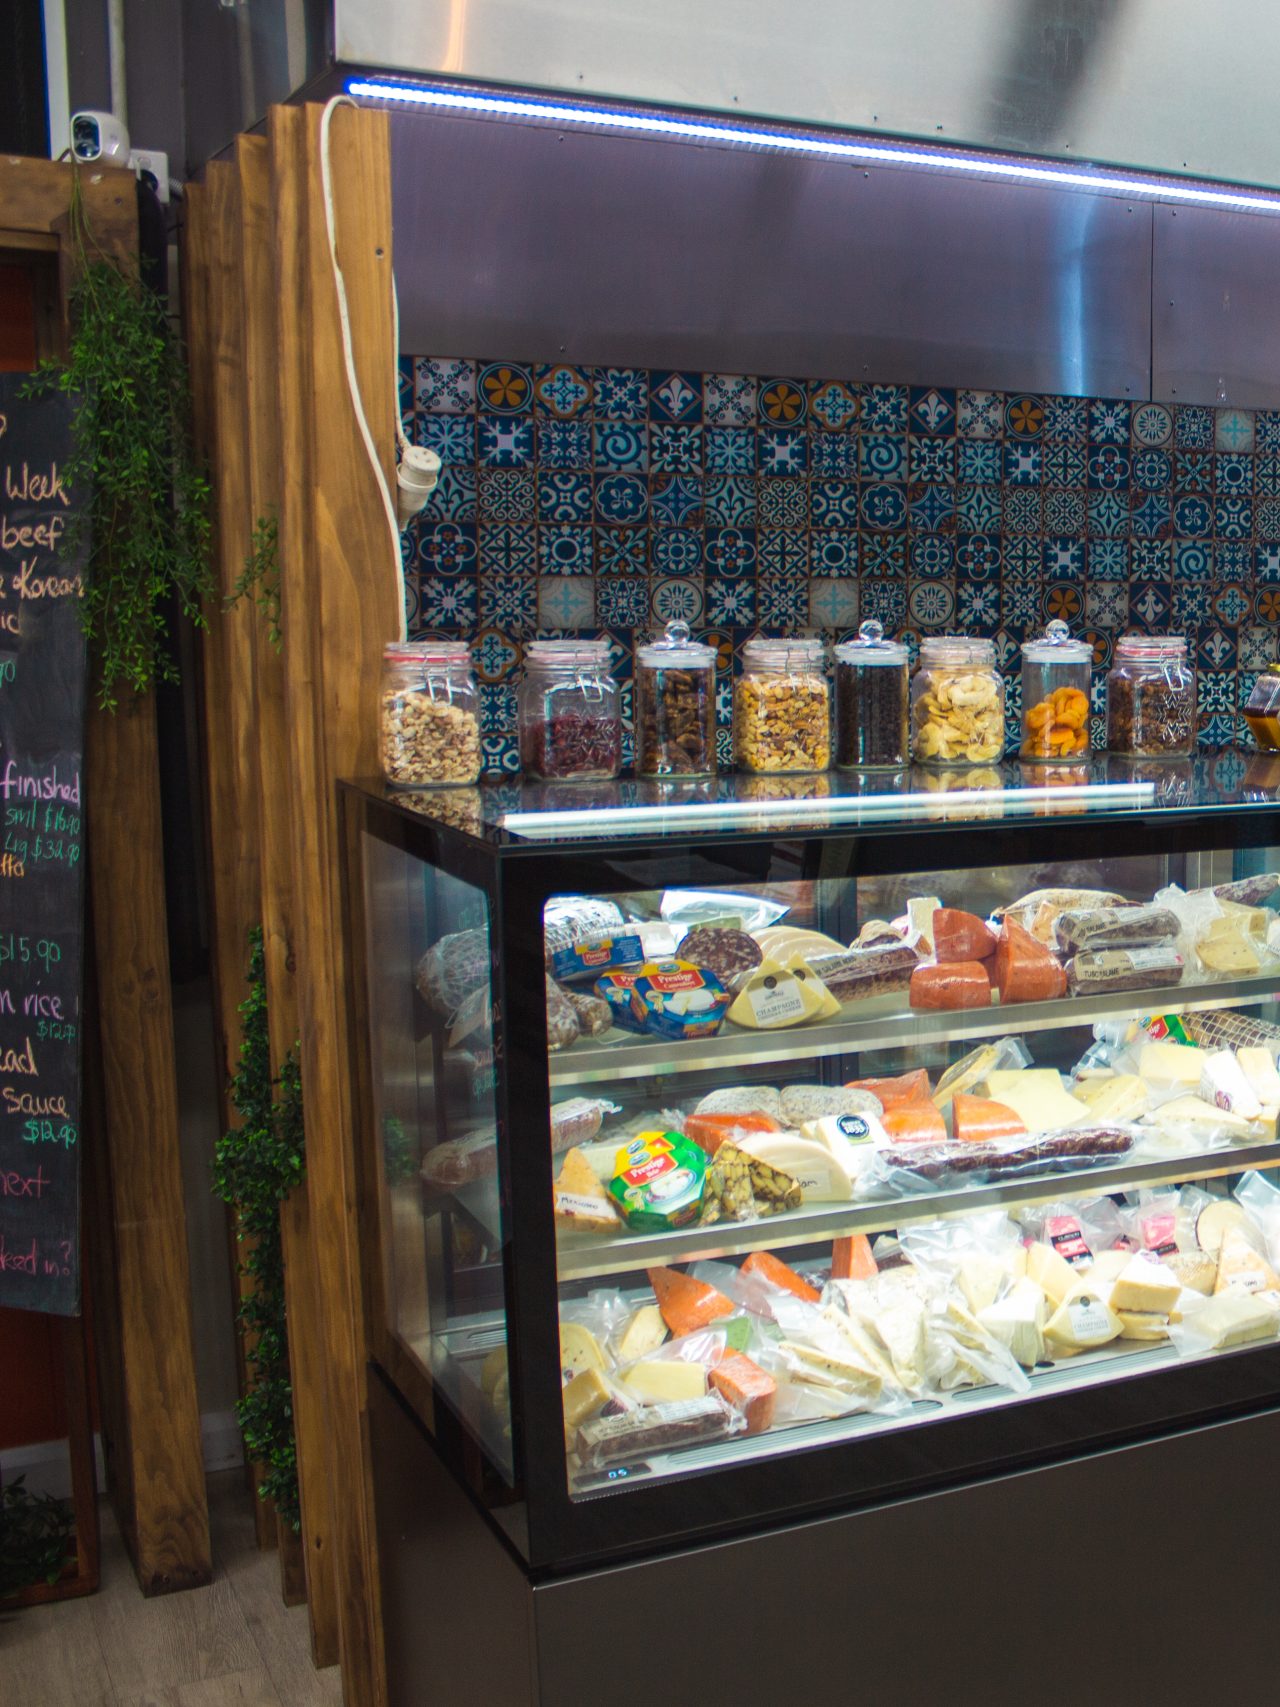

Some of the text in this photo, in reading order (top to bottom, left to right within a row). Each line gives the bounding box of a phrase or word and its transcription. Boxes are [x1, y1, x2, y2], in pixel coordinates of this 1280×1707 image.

[1, 514, 65, 551] beef
[0, 760, 81, 810] finished
[657, 973, 694, 984] Prestige
[755, 999, 801, 1018] CHAMPAGNE
[2, 1086, 71, 1119] Sauce
[630, 1156, 666, 1179] Prestige
